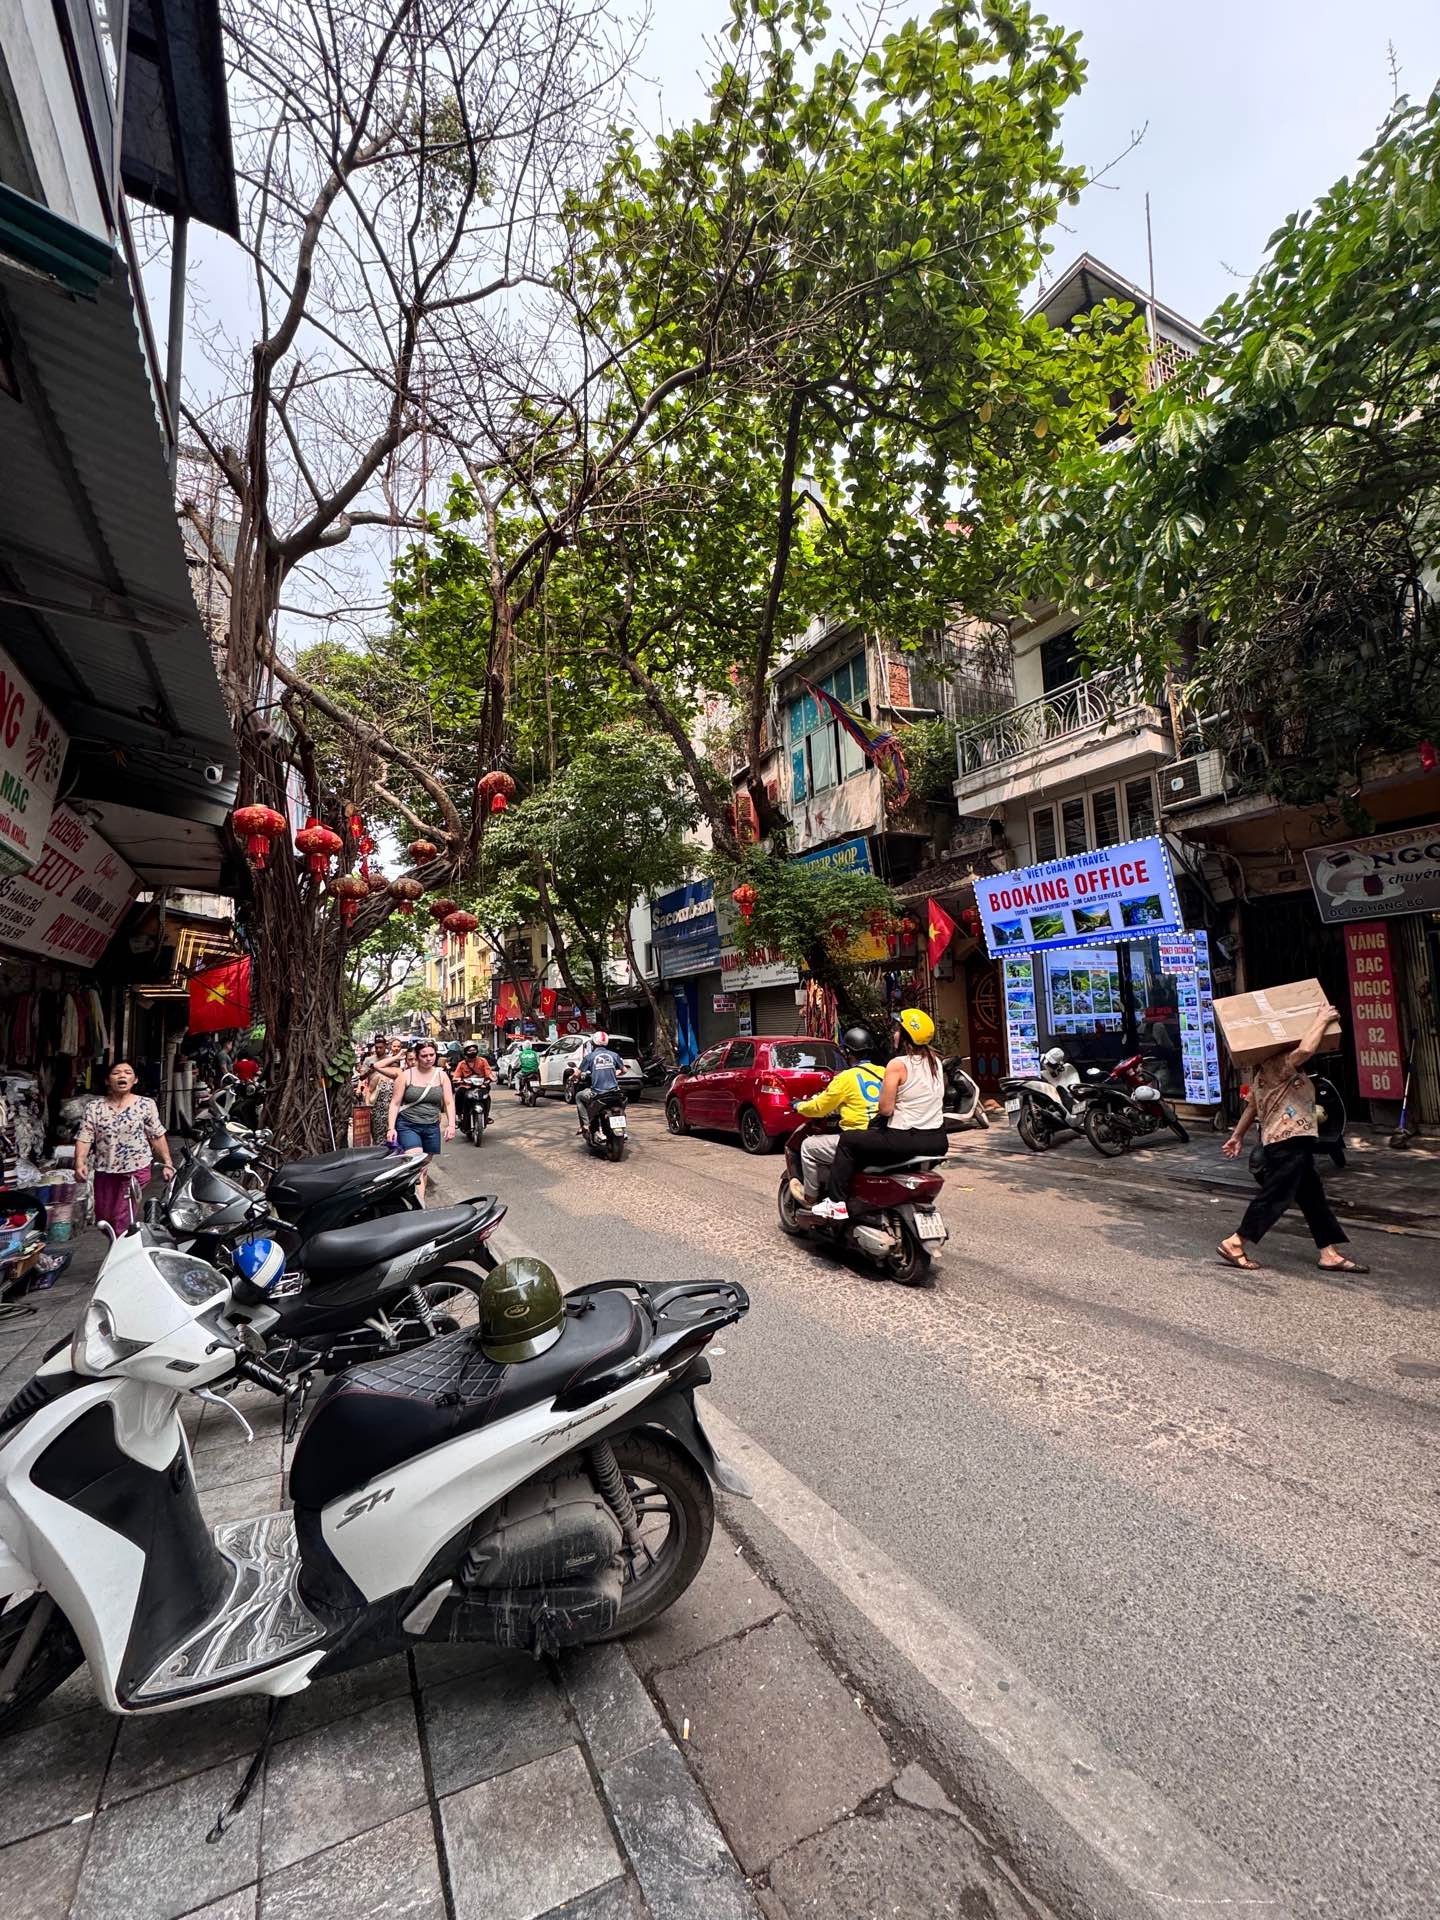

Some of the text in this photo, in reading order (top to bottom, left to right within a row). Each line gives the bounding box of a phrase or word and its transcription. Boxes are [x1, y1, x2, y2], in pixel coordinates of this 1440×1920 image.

[833, 846, 858, 868] SHOP
[1026, 853, 1110, 880] VIET CHARM TRAVEL
[988, 860, 1150, 912] BOOKING OFFICE
[1084, 895, 1097, 904] CARD
[1097, 890, 1123, 901] SERVICES
[1349, 932, 1385, 950] VÀNG
[1356, 956, 1383, 976] BẠC
[1353, 979, 1391, 999] NGỌC
[1356, 1000, 1393, 1019] CHÂU
[1368, 1027, 1385, 1043] 82
[1360, 1047, 1399, 1067] HÀNG
[336, 1488, 395, 1530] SH
